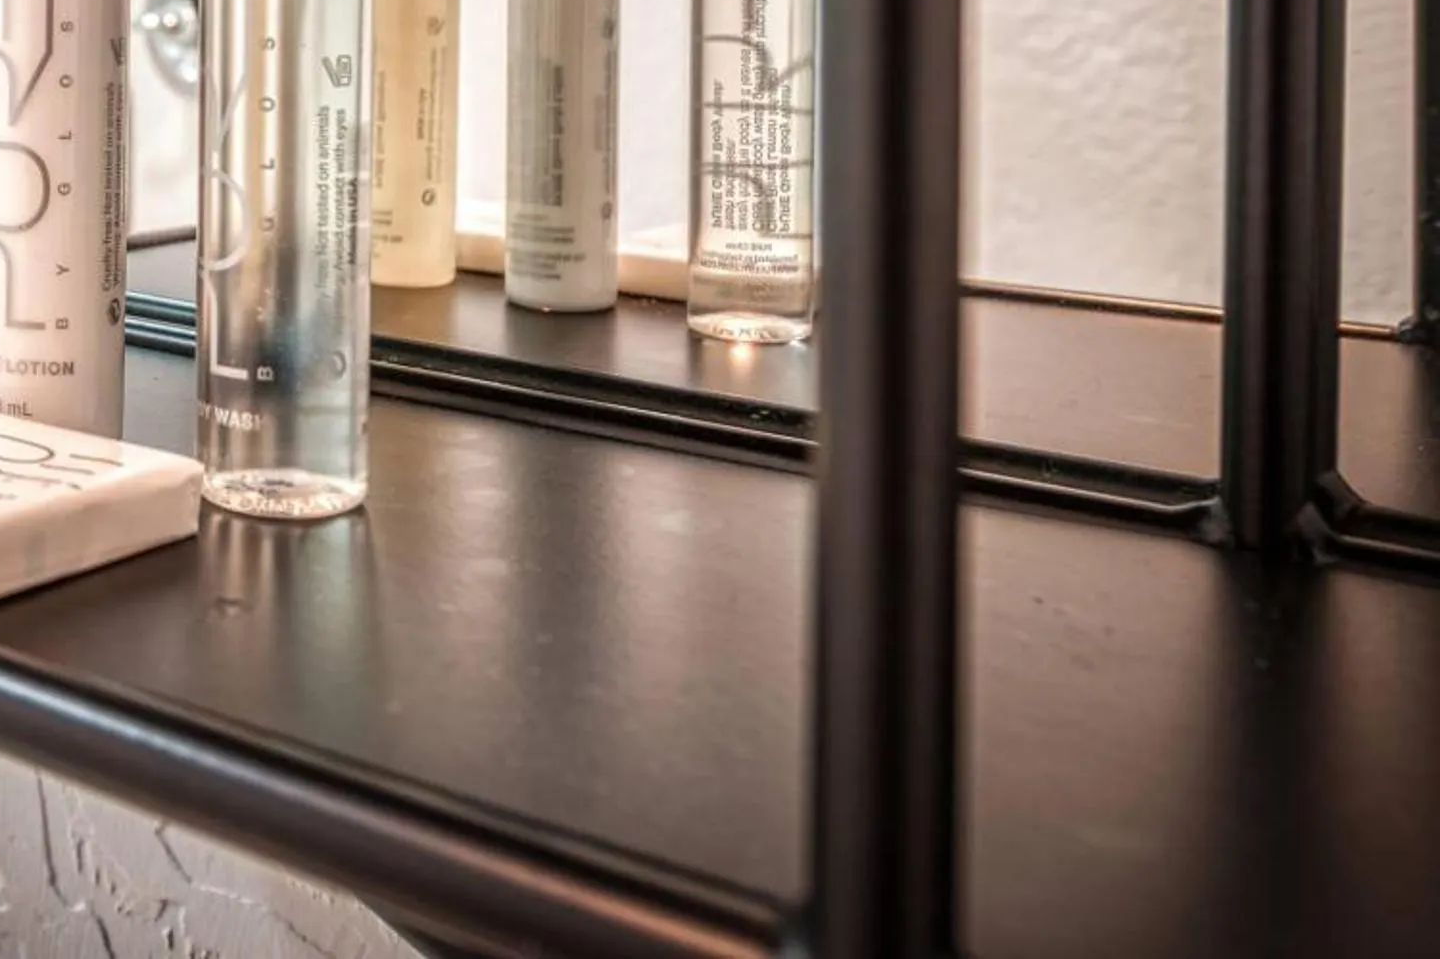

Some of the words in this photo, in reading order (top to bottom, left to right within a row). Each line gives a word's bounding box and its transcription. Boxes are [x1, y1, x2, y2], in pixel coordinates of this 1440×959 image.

[316, 106, 331, 159] animals
[335, 109, 349, 141] eyes
[319, 162, 330, 181] on
[334, 144, 346, 173] with
[316, 184, 330, 227] tested
[334, 178, 346, 229] contact
[6, 359, 75, 377] LOTION
[6, 402, 34, 418] mL
